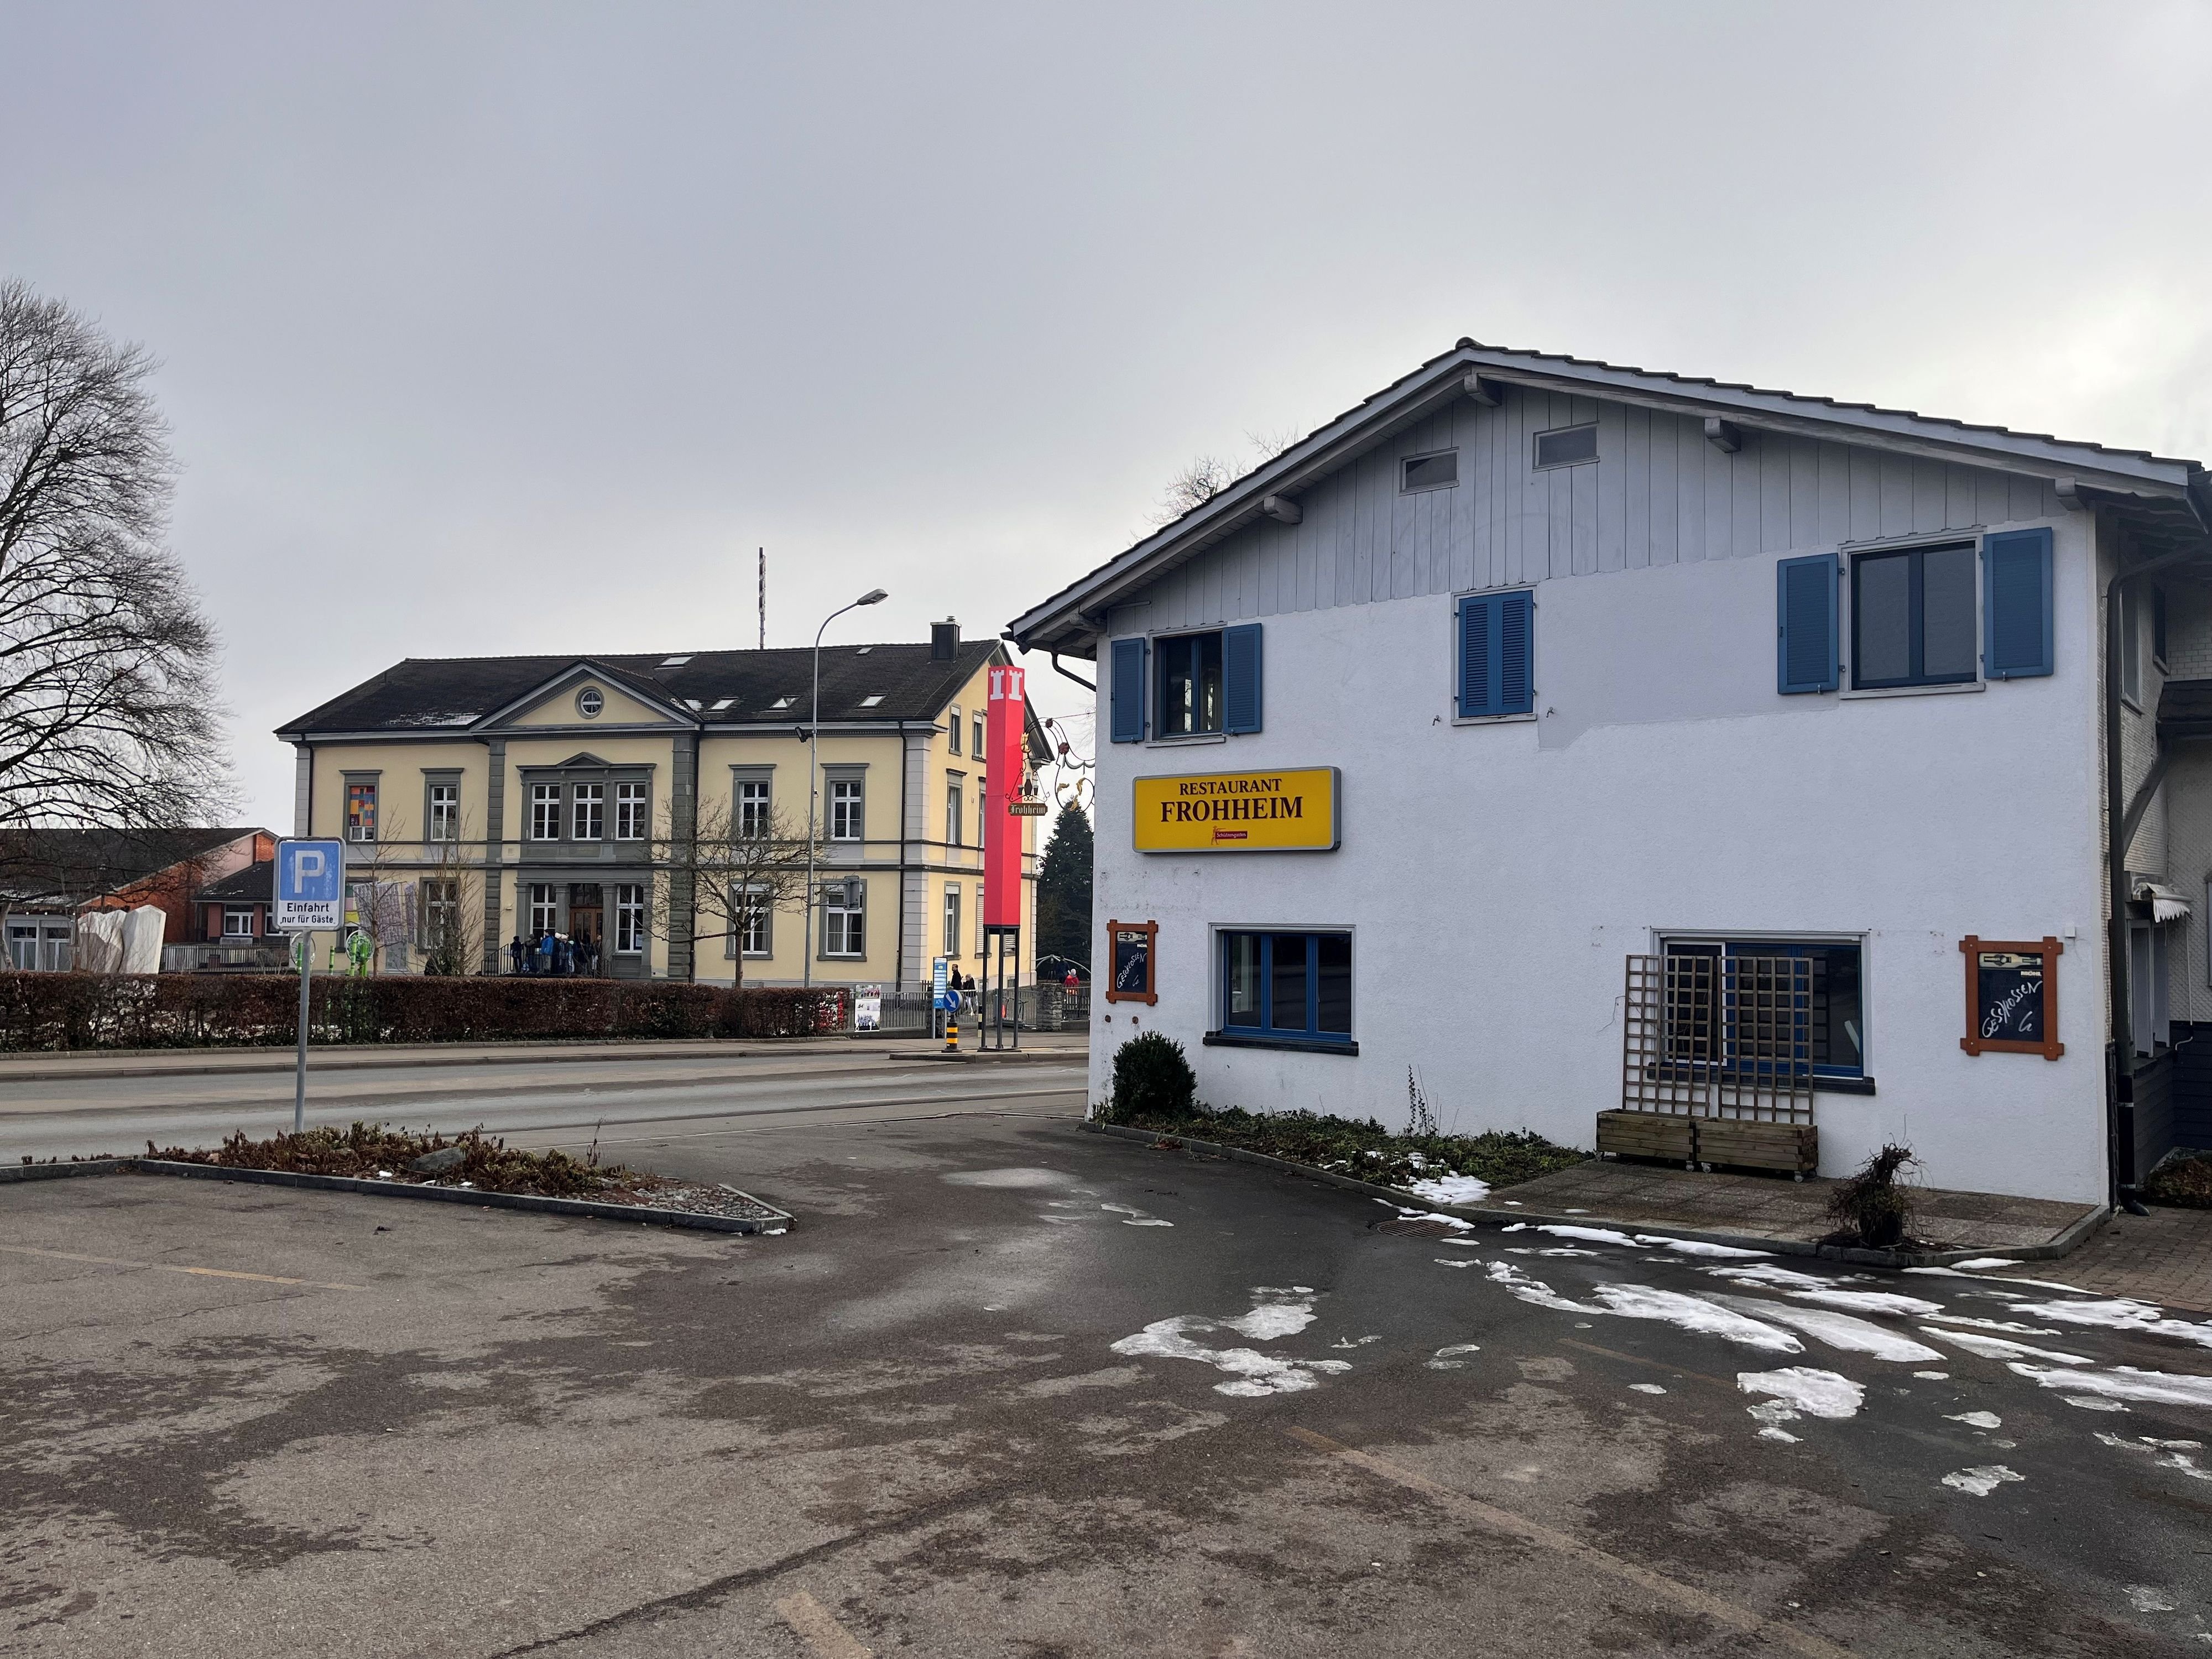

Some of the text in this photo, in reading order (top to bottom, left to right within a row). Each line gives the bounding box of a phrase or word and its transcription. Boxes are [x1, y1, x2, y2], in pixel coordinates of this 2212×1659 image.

[1179, 778, 1282, 795] RESTAURANT
[1009, 805, 1046, 815] Frohheim
[1161, 796, 1303, 822] FROHHEIM
[294, 850, 325, 894] P
[287, 902, 330, 912] Einfahrt
[298, 915, 309, 924] für
[311, 915, 333, 924] Gäste
